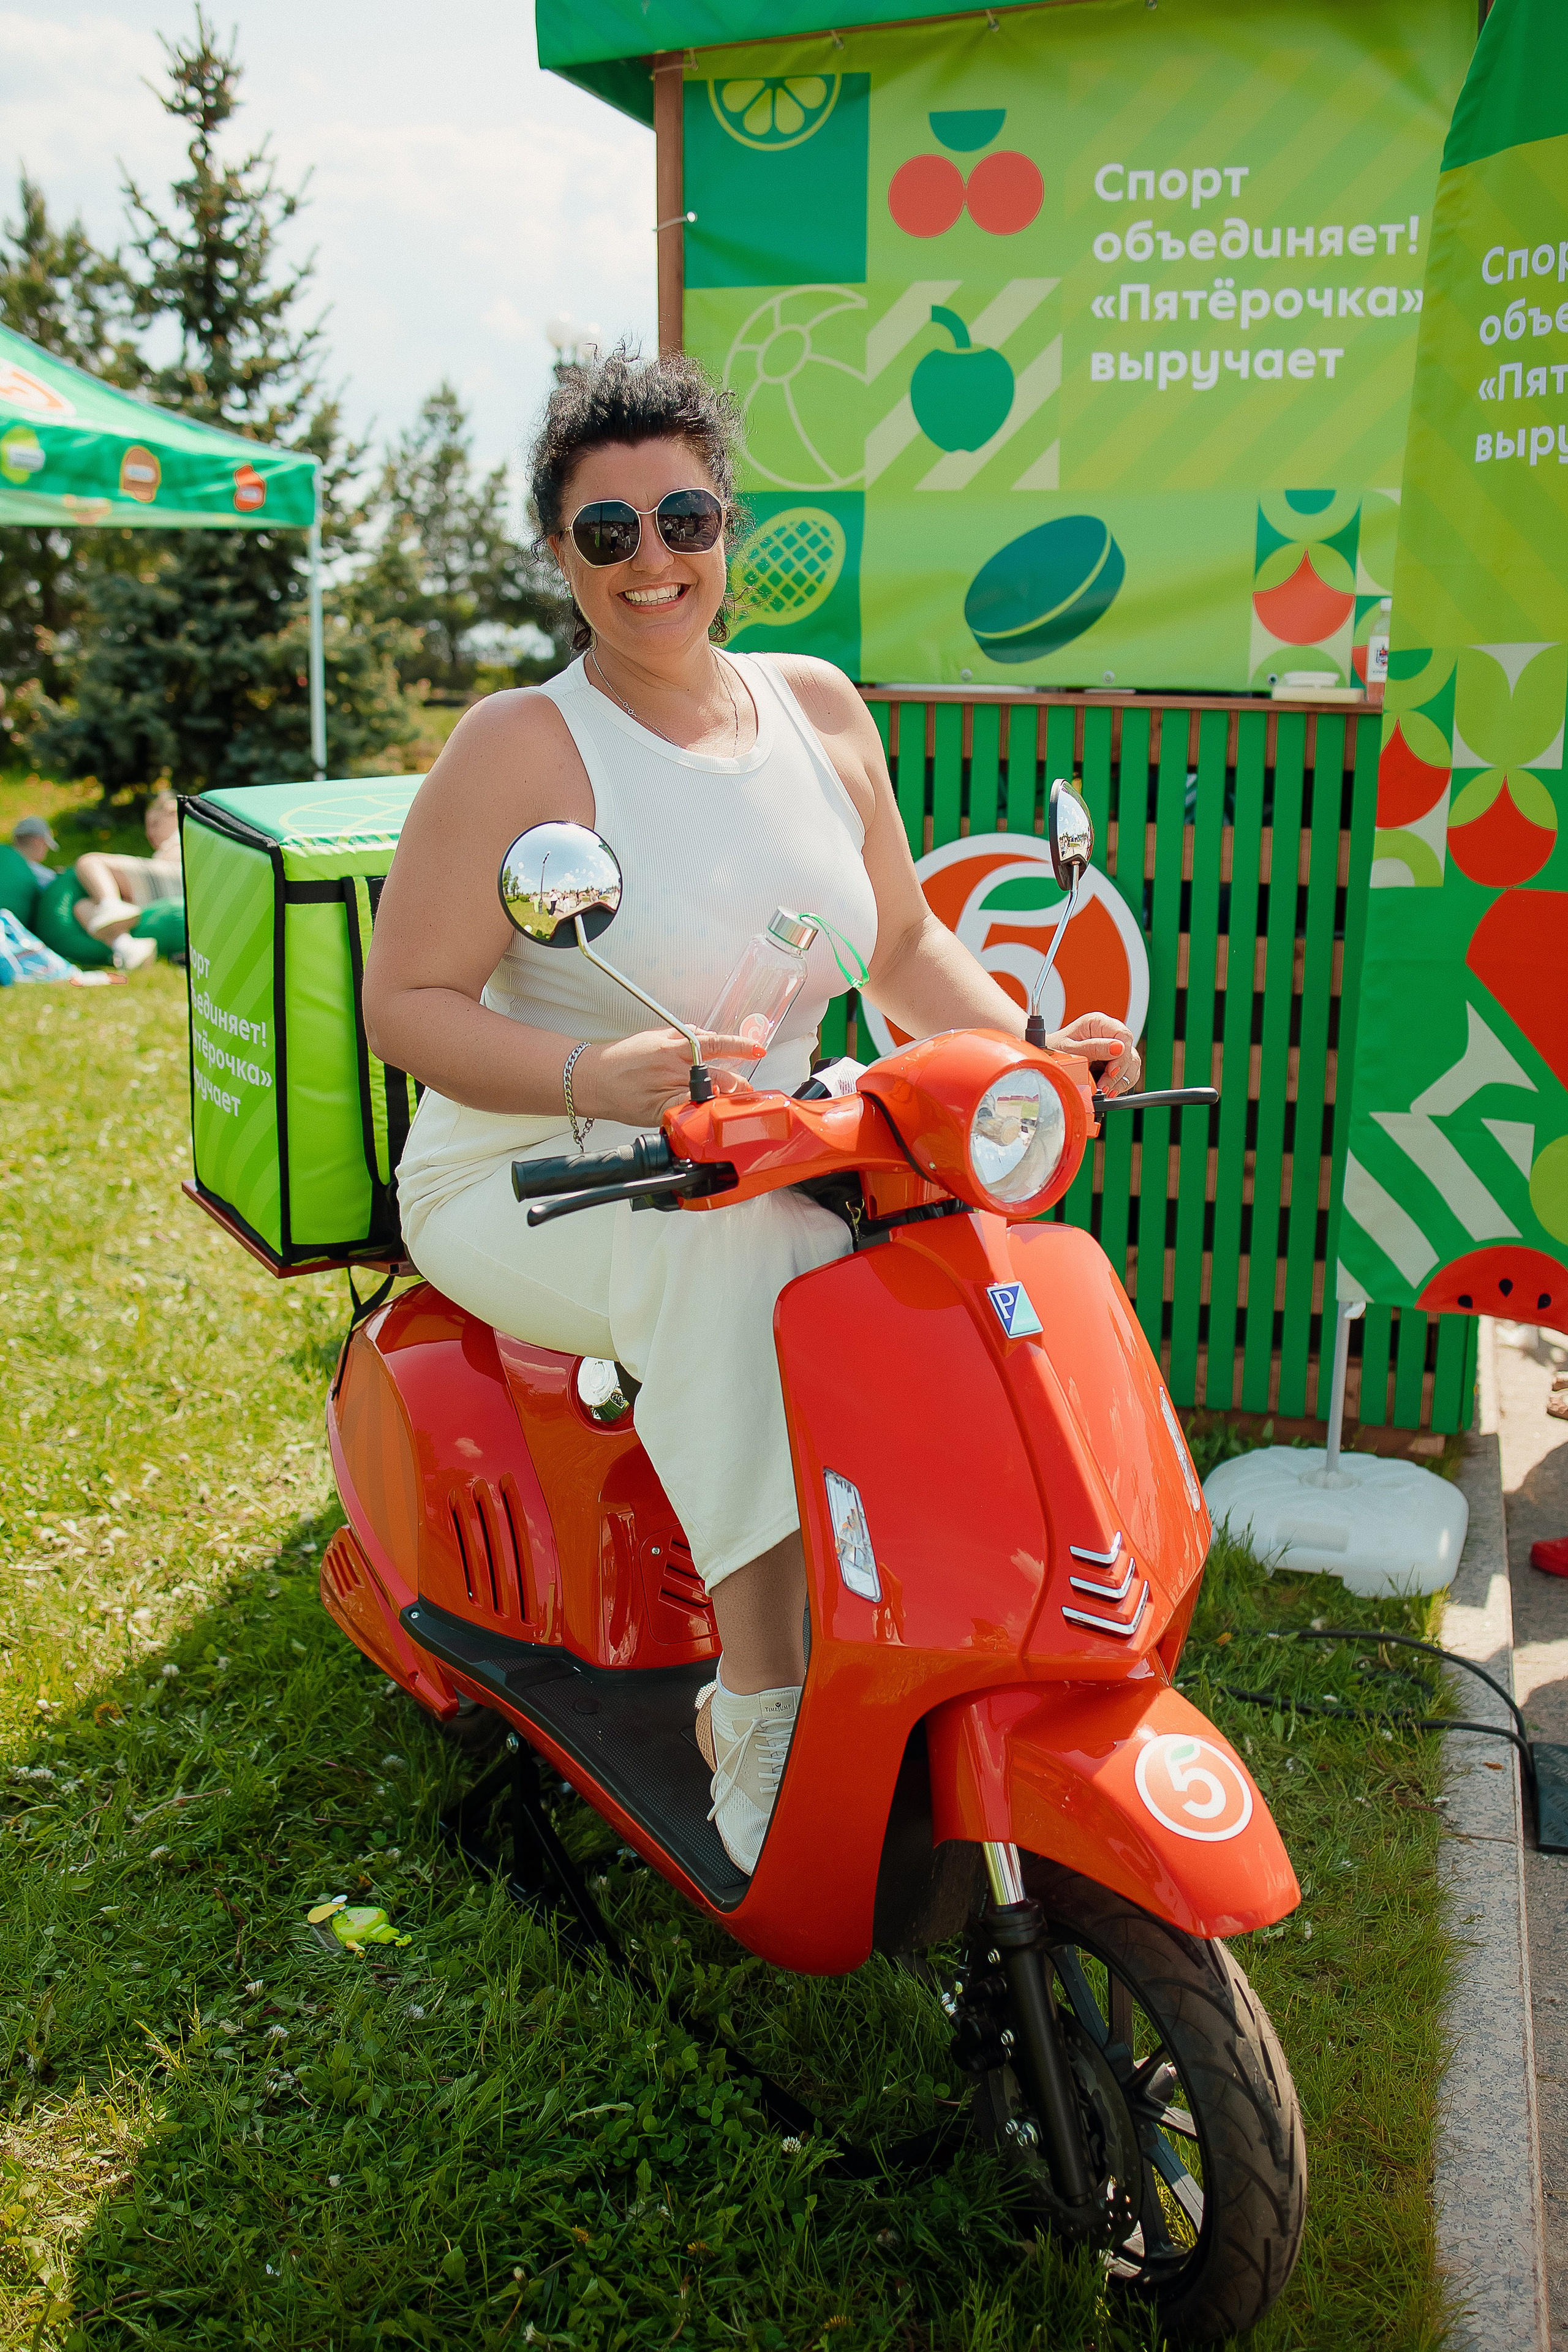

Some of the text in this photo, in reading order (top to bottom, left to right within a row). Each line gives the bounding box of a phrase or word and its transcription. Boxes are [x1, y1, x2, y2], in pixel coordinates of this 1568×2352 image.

[1094, 162, 1249, 209] Спорт
[1093, 214, 1420, 262] объединяет!
[1090, 277, 1423, 330] «Пятёрочка»
[1090, 347, 1344, 391] выручает
[1478, 361, 1568, 401] «Пят
[993, 1290, 1015, 1319] P
